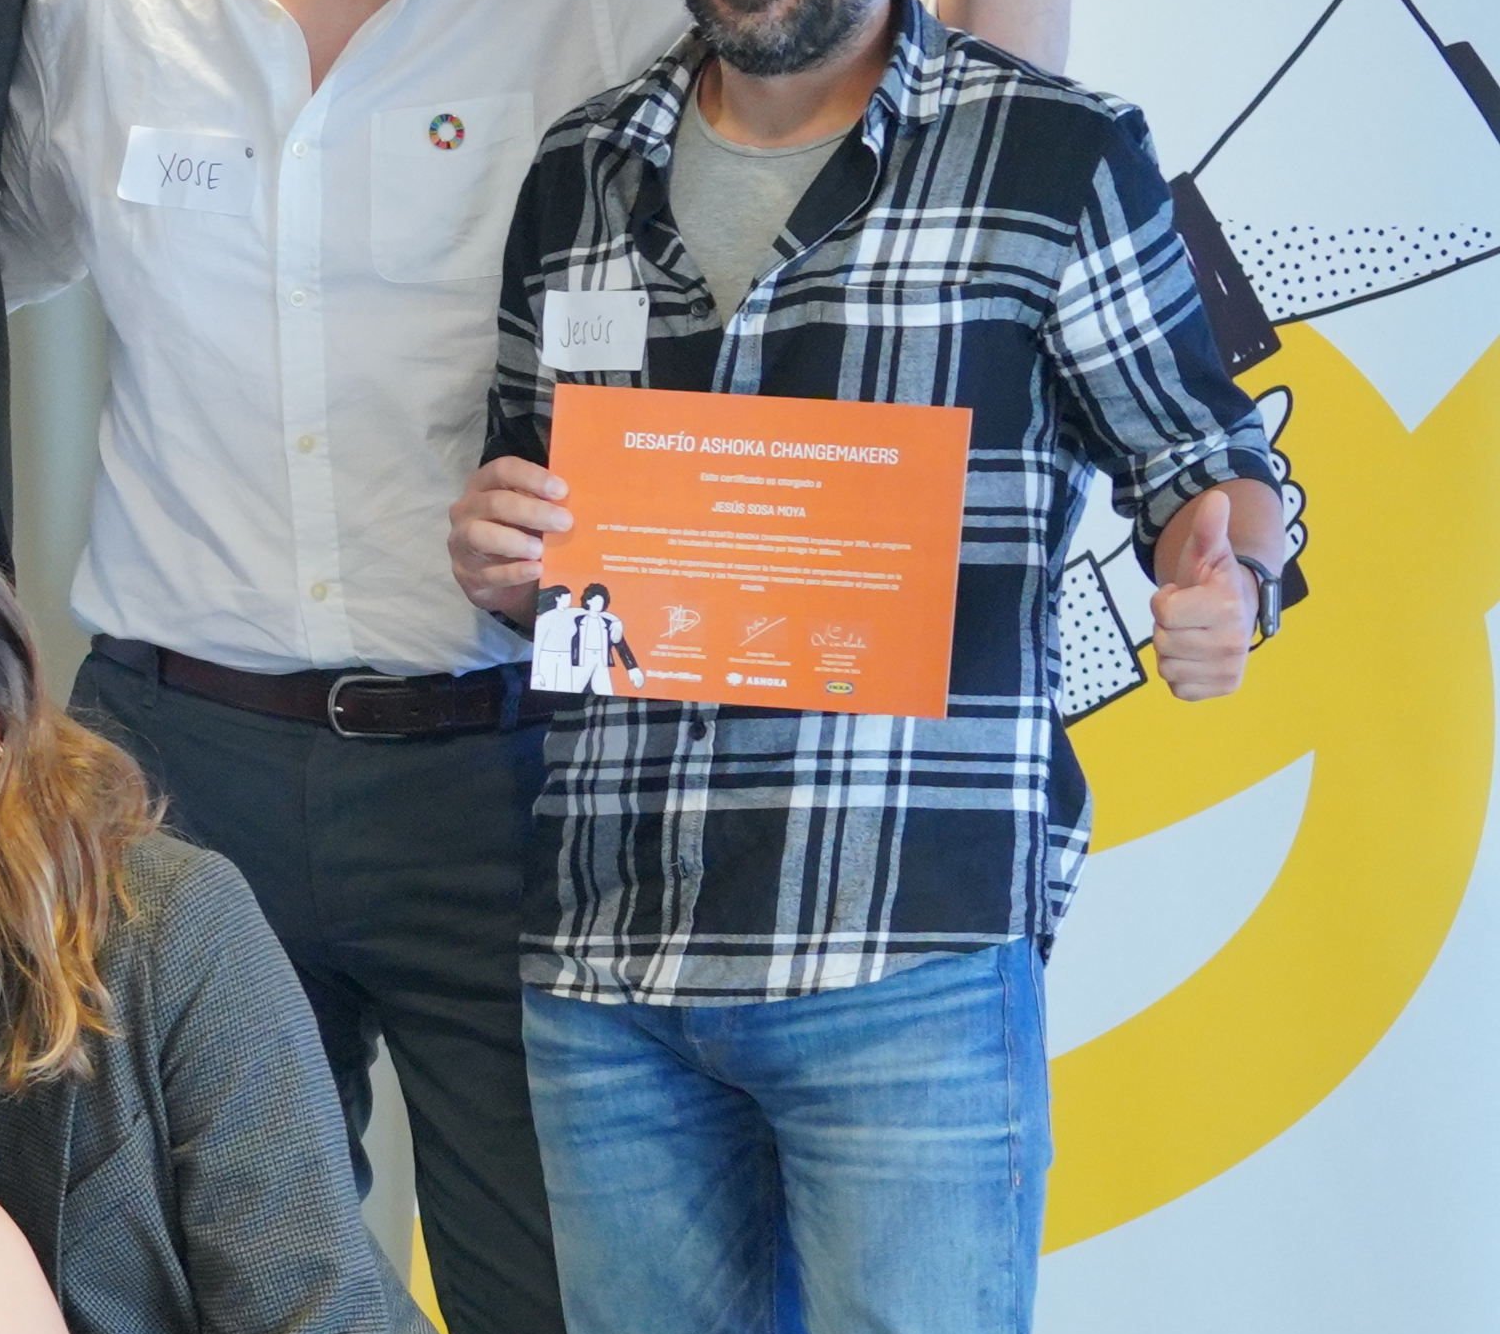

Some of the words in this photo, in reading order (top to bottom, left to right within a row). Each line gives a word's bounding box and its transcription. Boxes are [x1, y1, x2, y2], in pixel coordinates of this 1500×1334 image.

[624, 430, 696, 452] DESAFÍO
[699, 437, 766, 456] ASHOKA
[770, 441, 899, 465] CHANGEMAKERS
[700, 472, 720, 482] Este
[719, 474, 765, 485] certificado
[777, 478, 816, 489] otorgado
[746, 677, 787, 688] ASHOKA
